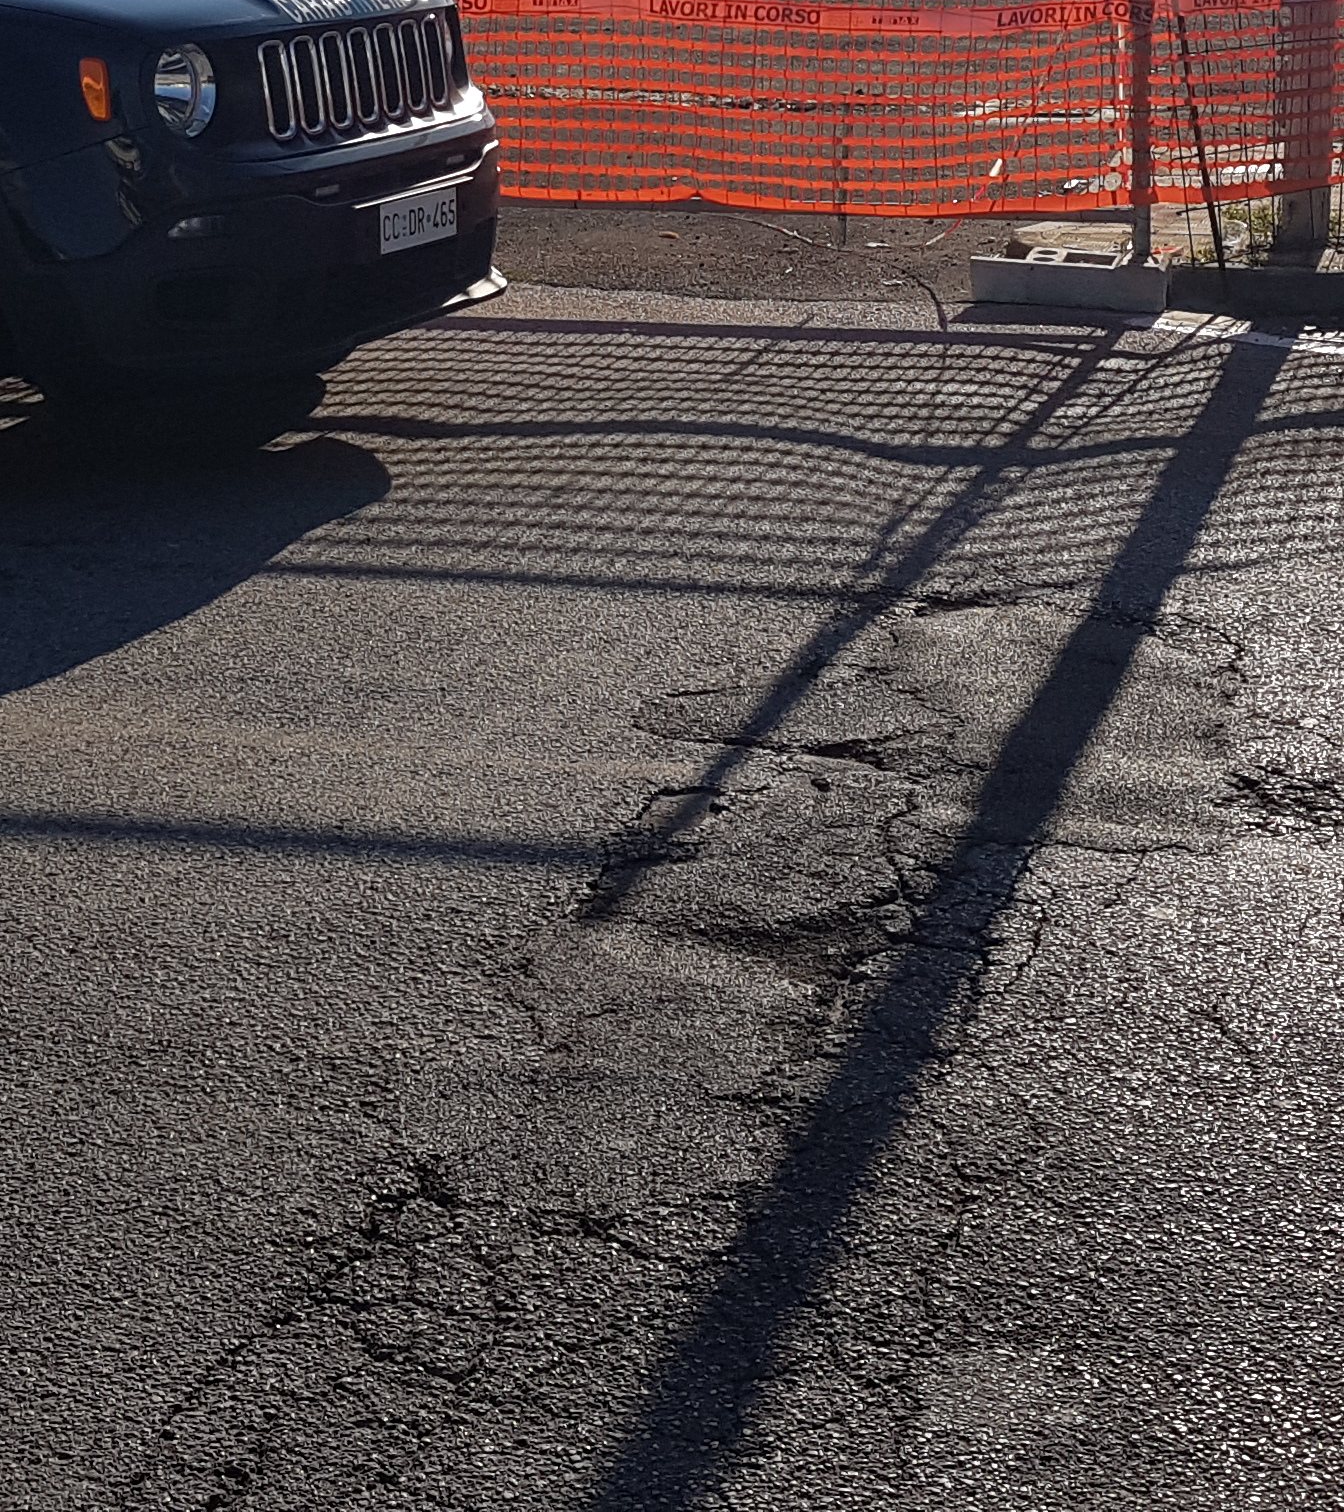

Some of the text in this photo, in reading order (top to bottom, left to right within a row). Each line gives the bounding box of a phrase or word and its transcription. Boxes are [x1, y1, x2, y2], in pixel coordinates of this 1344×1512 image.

[726, 3, 748, 20] IN
[755, 5, 821, 25] CORSO
[997, 1, 1153, 28] LAVORI IN CORS
